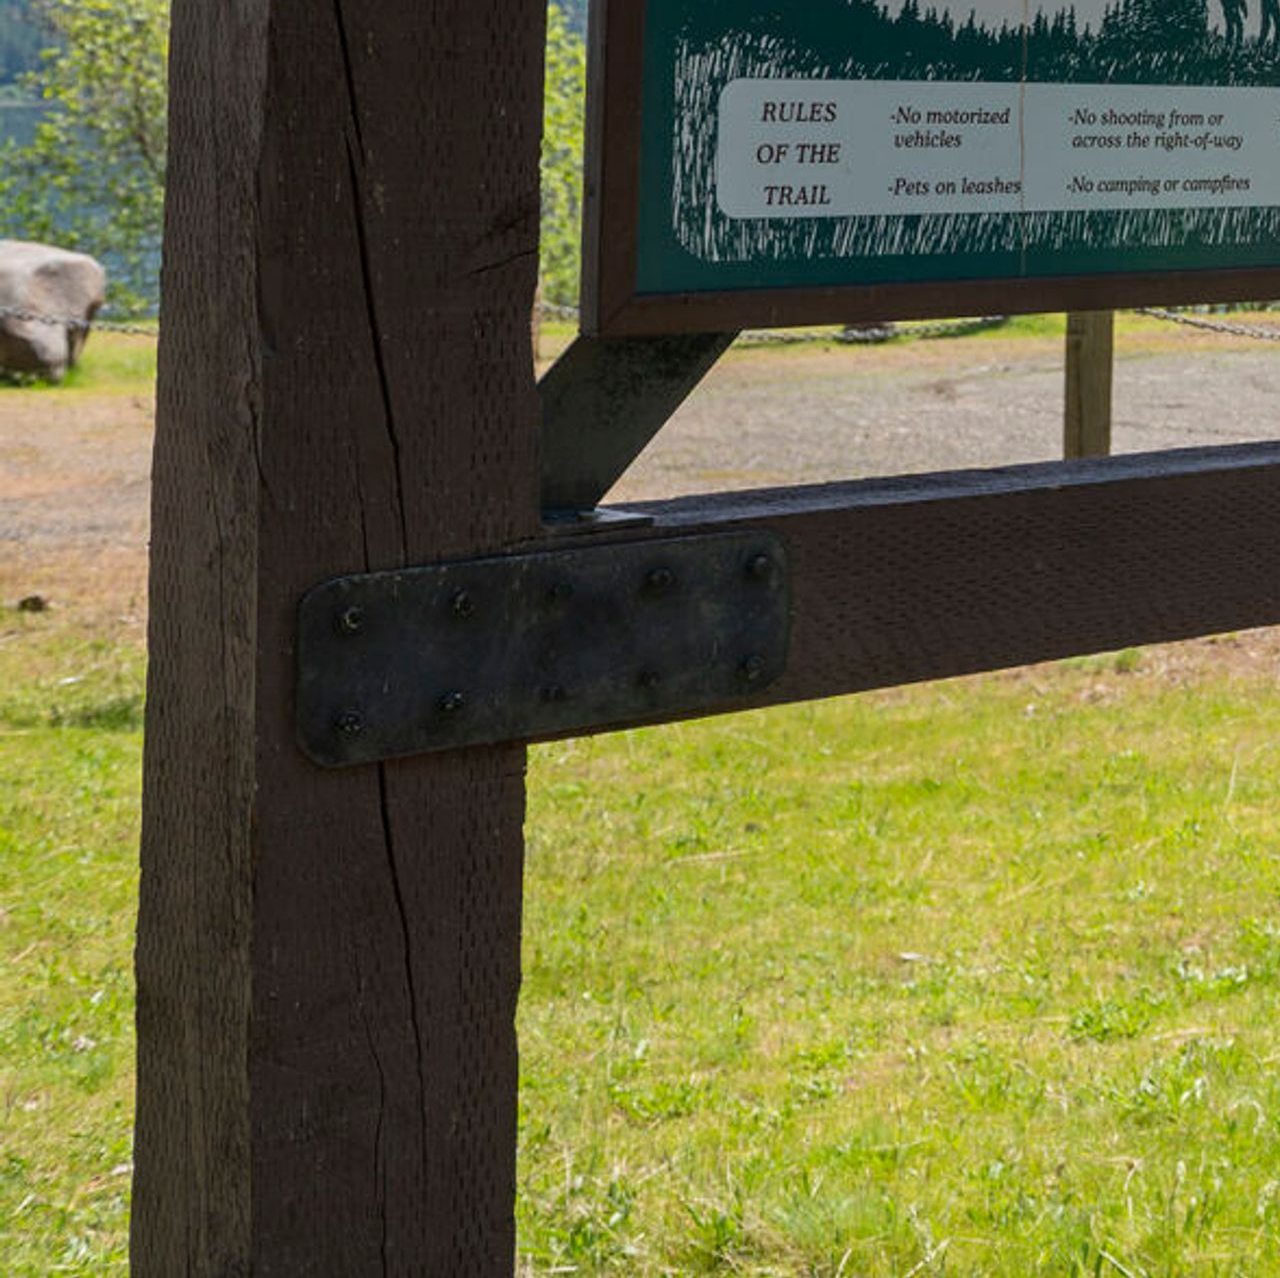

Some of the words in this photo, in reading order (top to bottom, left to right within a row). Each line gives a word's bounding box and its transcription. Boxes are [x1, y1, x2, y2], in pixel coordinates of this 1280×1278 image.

[762, 100, 837, 122] RULES
[891, 107, 921, 122] -No
[926, 107, 1009, 124] motorized
[1069, 109, 1096, 123] -No
[1101, 109, 1164, 129] shooting
[1169, 111, 1203, 130] from
[1207, 116, 1224, 126] or
[894, 130, 961, 146] vehicles
[1072, 135, 1121, 146] across
[1126, 131, 1149, 145] the
[1154, 131, 1242, 150] right-of-way
[756, 142, 787, 163] OF
[797, 143, 840, 163] THE
[763, 184, 831, 205] TRAIL
[888, 178, 929, 194] -Pets
[935, 183, 956, 194] on
[961, 177, 1021, 193] leashes
[1067, 177, 1093, 192] -No
[1097, 176, 1160, 196] camping
[1163, 181, 1179, 191] or
[1182, 176, 1249, 195] campfires
